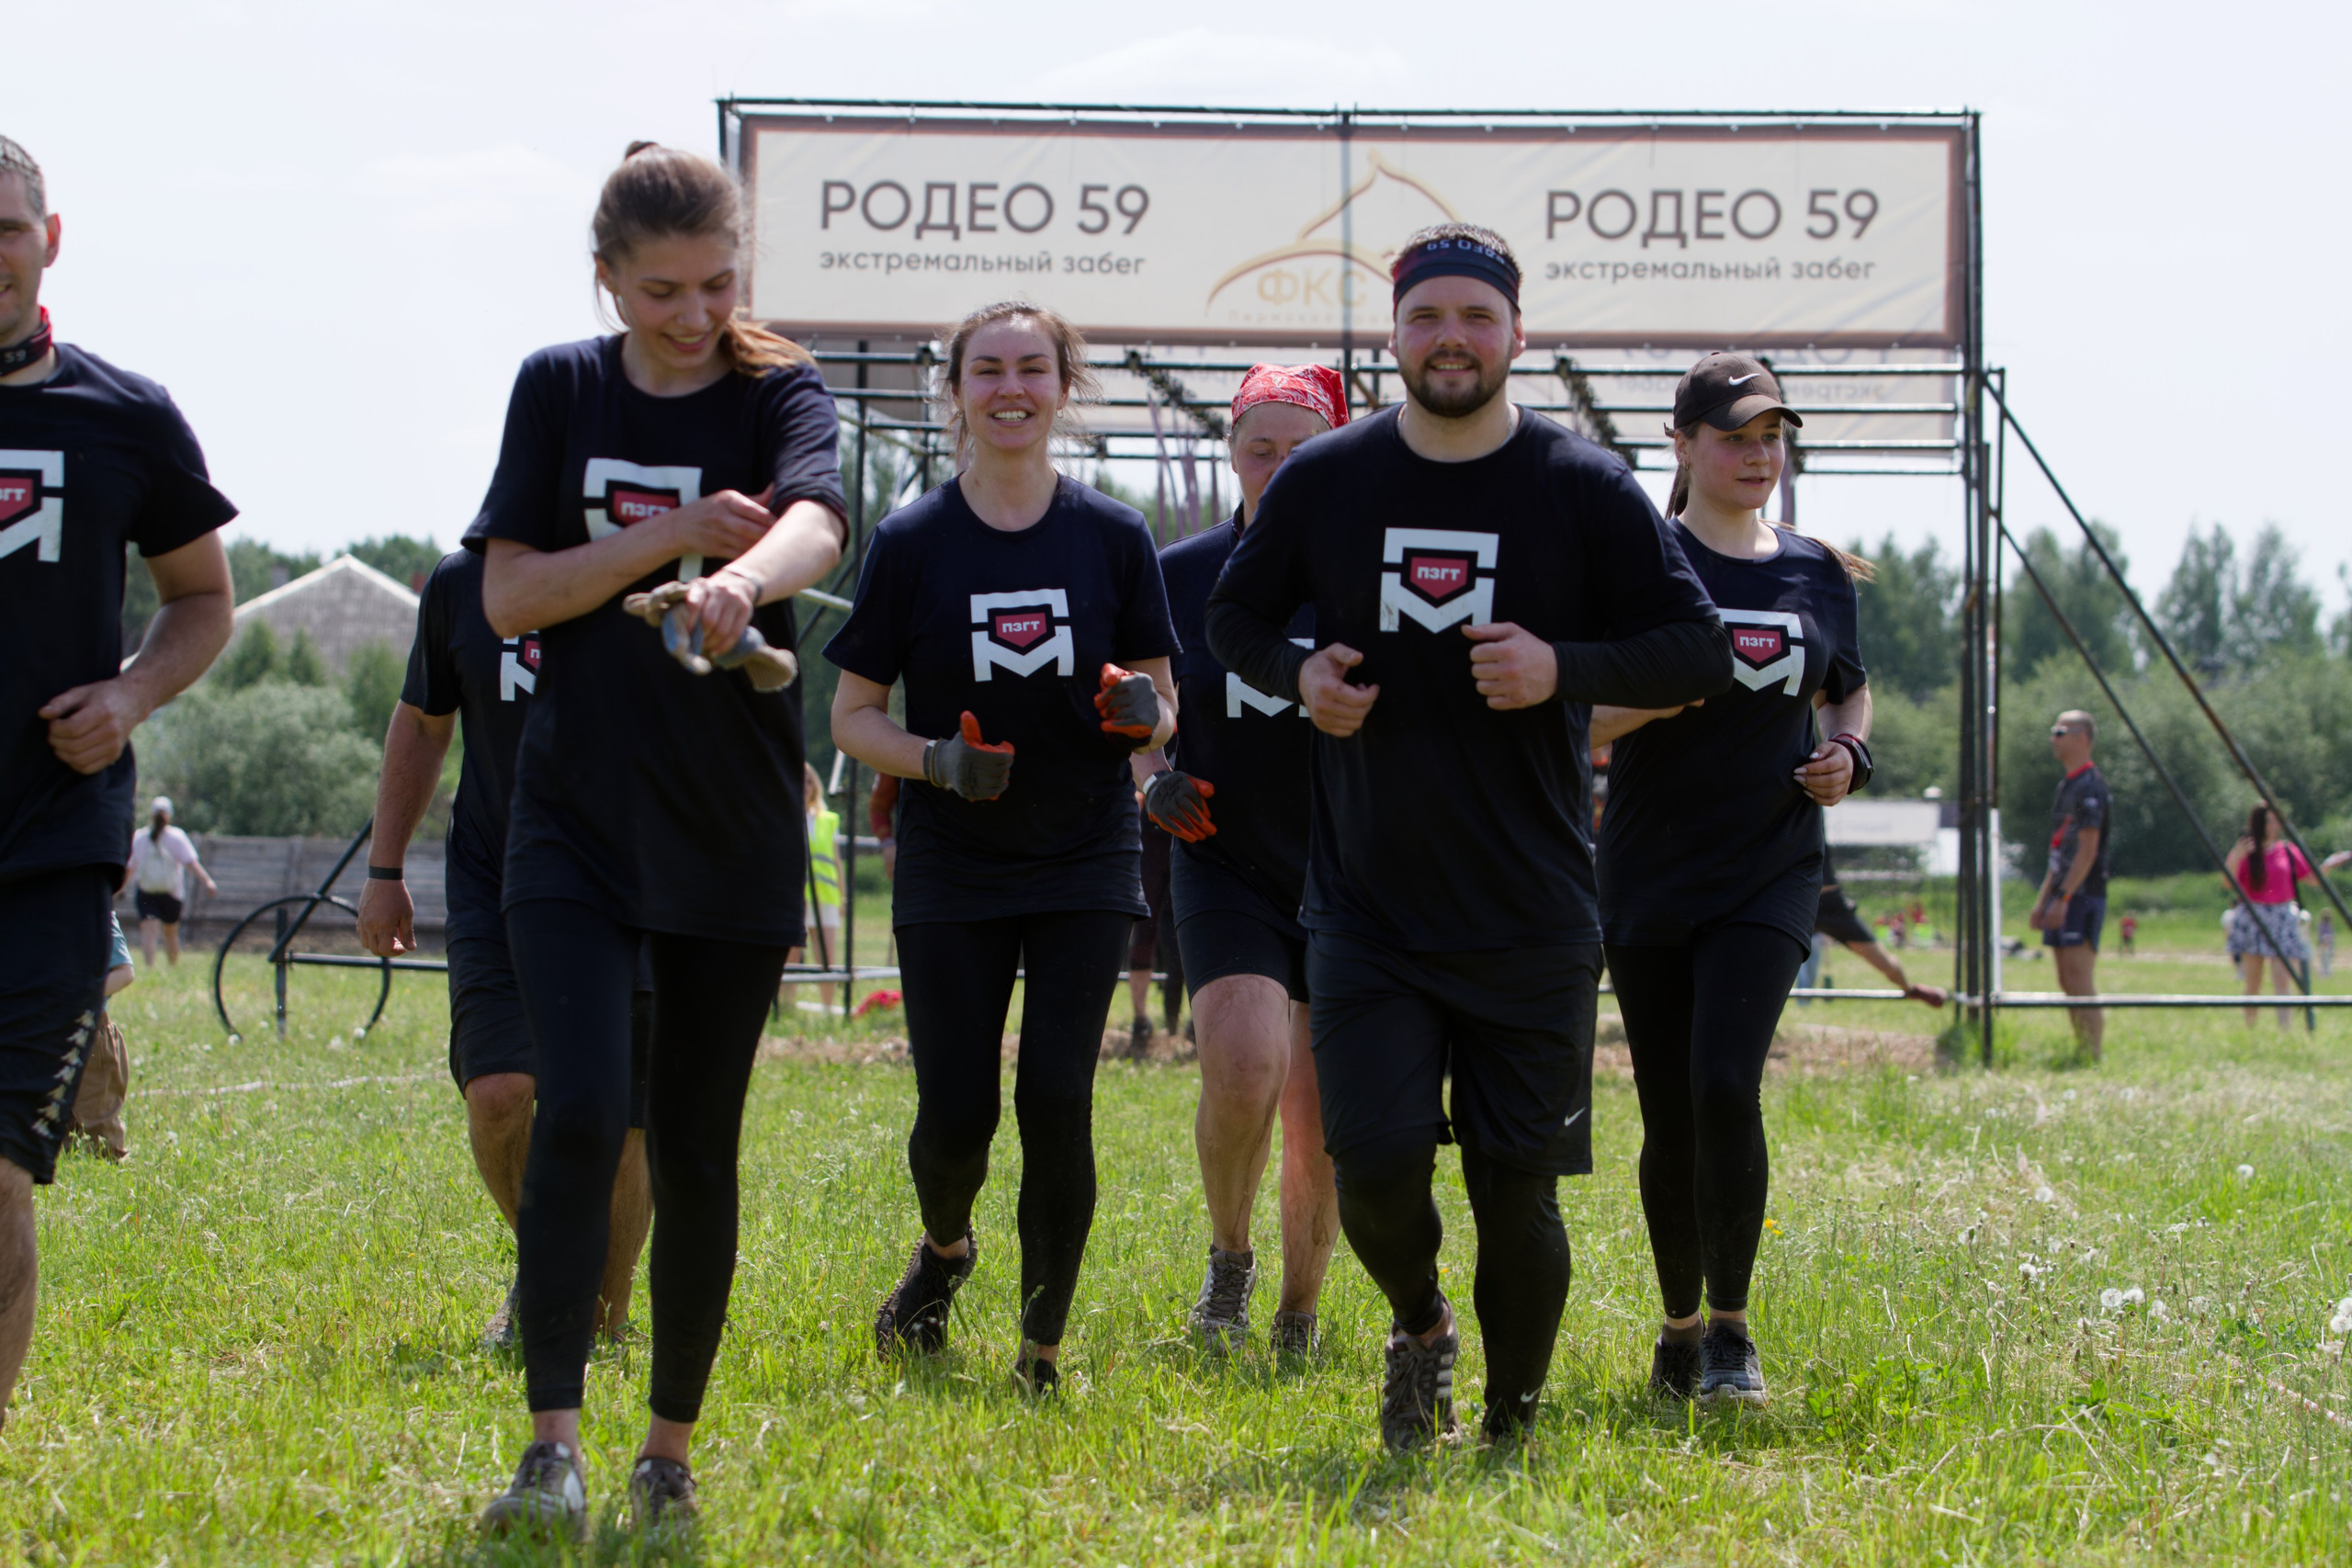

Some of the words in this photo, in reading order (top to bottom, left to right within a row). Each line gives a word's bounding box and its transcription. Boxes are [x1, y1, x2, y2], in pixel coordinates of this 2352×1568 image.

[820, 179, 1054, 241] РОДЕО
[1077, 185, 1149, 235] 59
[1546, 188, 1781, 249] РОДЕО
[1805, 188, 1879, 241] 59
[820, 250, 1052, 275] экстремальный
[1063, 251, 1146, 274] забег
[1545, 255, 1781, 284] экстремальный
[1792, 255, 1876, 279] забег
[1256, 267, 1368, 308] ФКС
[0, 487, 26, 502] ГТ
[1417, 566, 1461, 581] ПЗГТ
[1001, 620, 1040, 634] ПЗГТ
[1739, 636, 1775, 649] ПЗГТ
